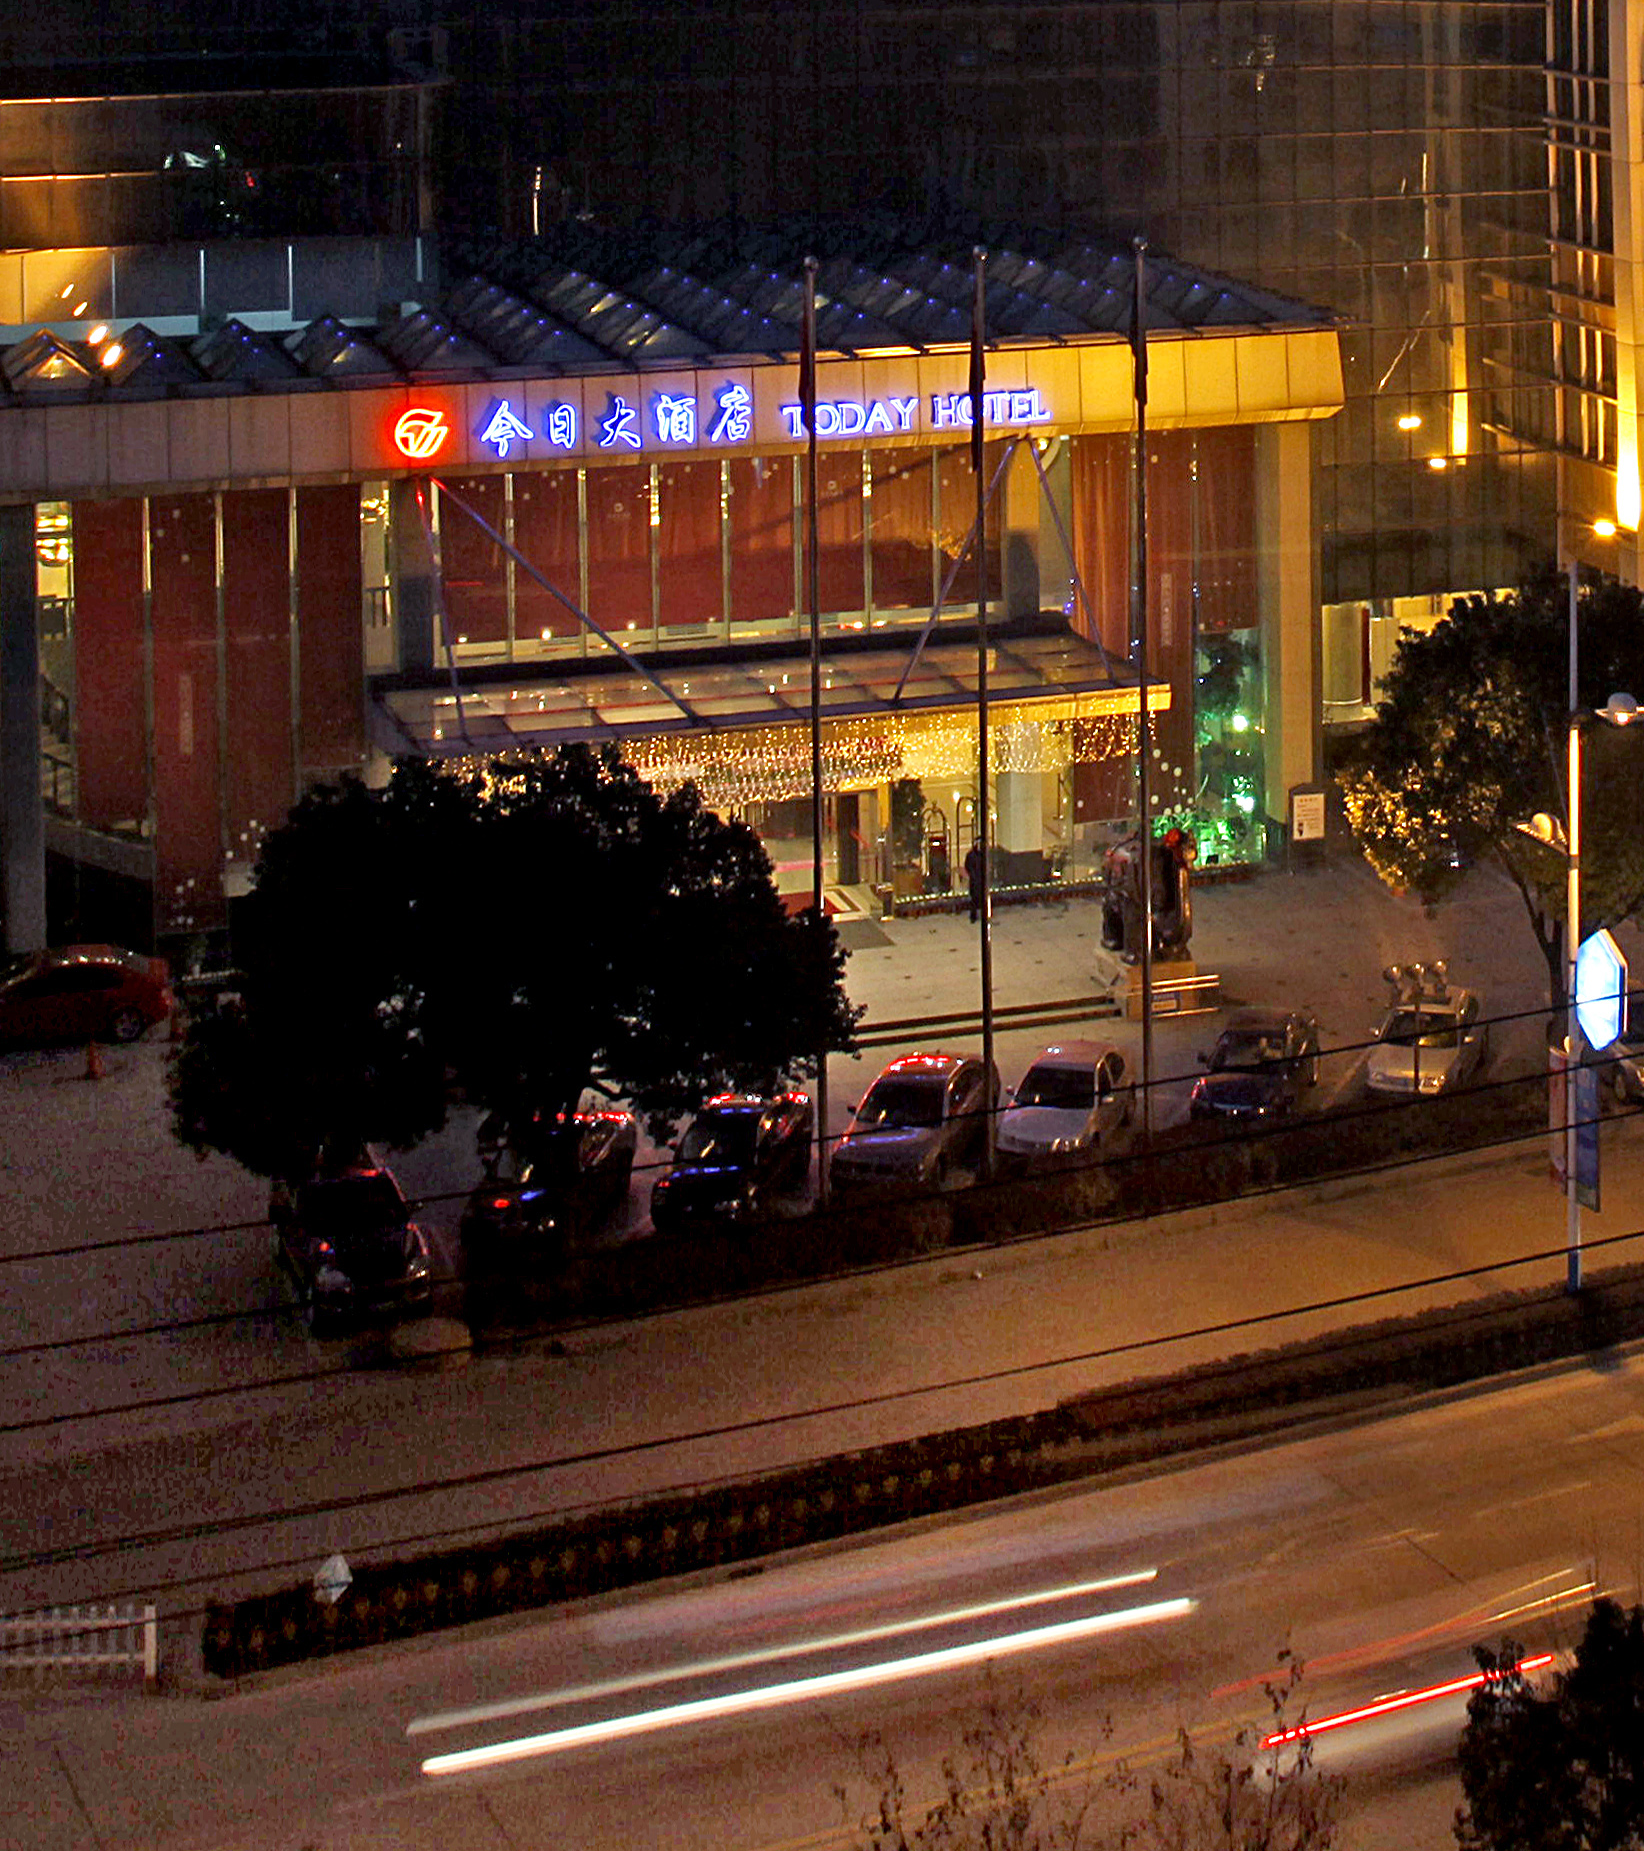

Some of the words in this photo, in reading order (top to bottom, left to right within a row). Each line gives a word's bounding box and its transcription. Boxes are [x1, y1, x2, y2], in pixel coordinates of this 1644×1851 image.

[481, 384, 751, 458] 今日大酒店
[781, 397, 919, 438] TODAY
[932, 389, 1051, 428] HOTEL
